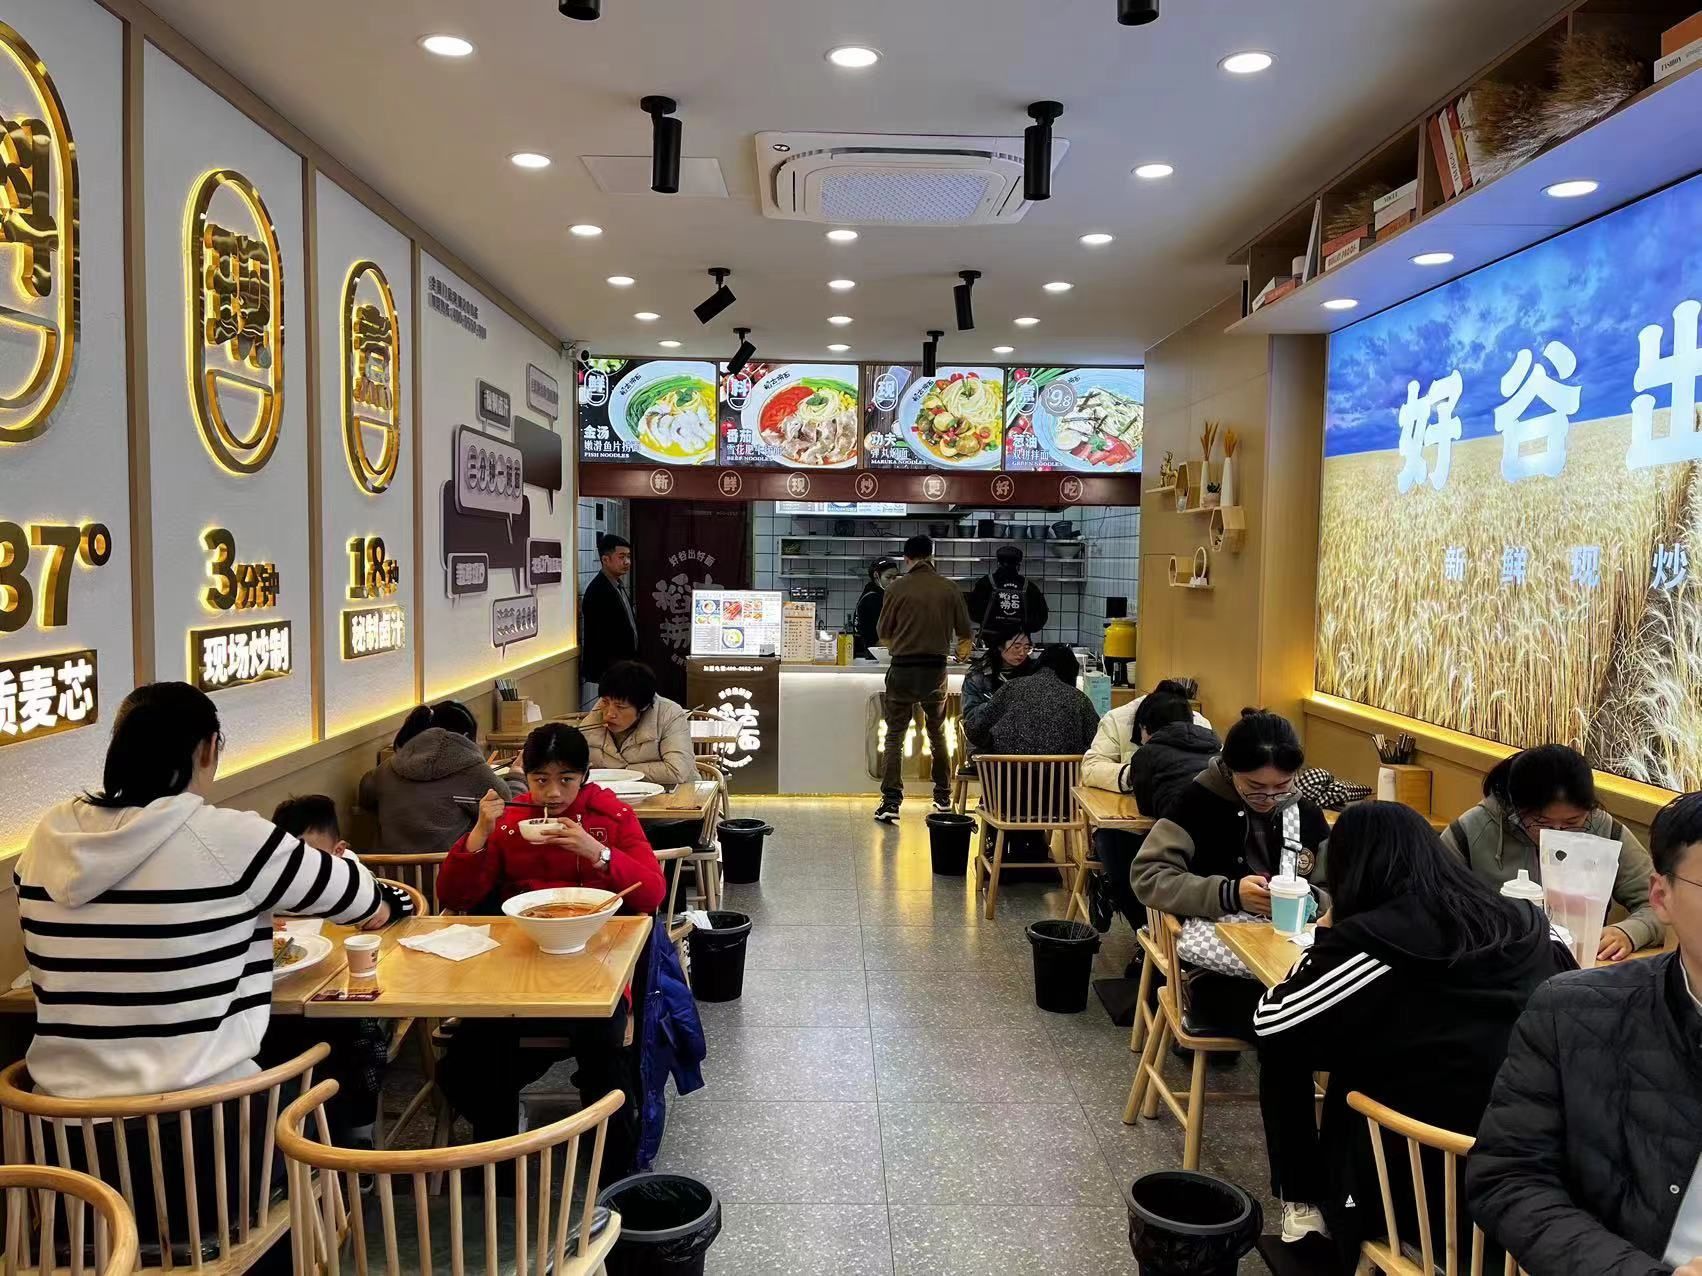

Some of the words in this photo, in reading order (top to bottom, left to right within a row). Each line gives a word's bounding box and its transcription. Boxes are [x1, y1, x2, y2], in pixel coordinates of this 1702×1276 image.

[203, 224, 271, 369] 现
[584, 425, 609, 439] 金汤
[727, 428, 752, 443] 番茄
[871, 432, 897, 446] 功夫
[1013, 434, 1038, 449] 葱油
[351, 610, 404, 655] 秘制卤汁
[203, 627, 290, 684] 现场炒制
